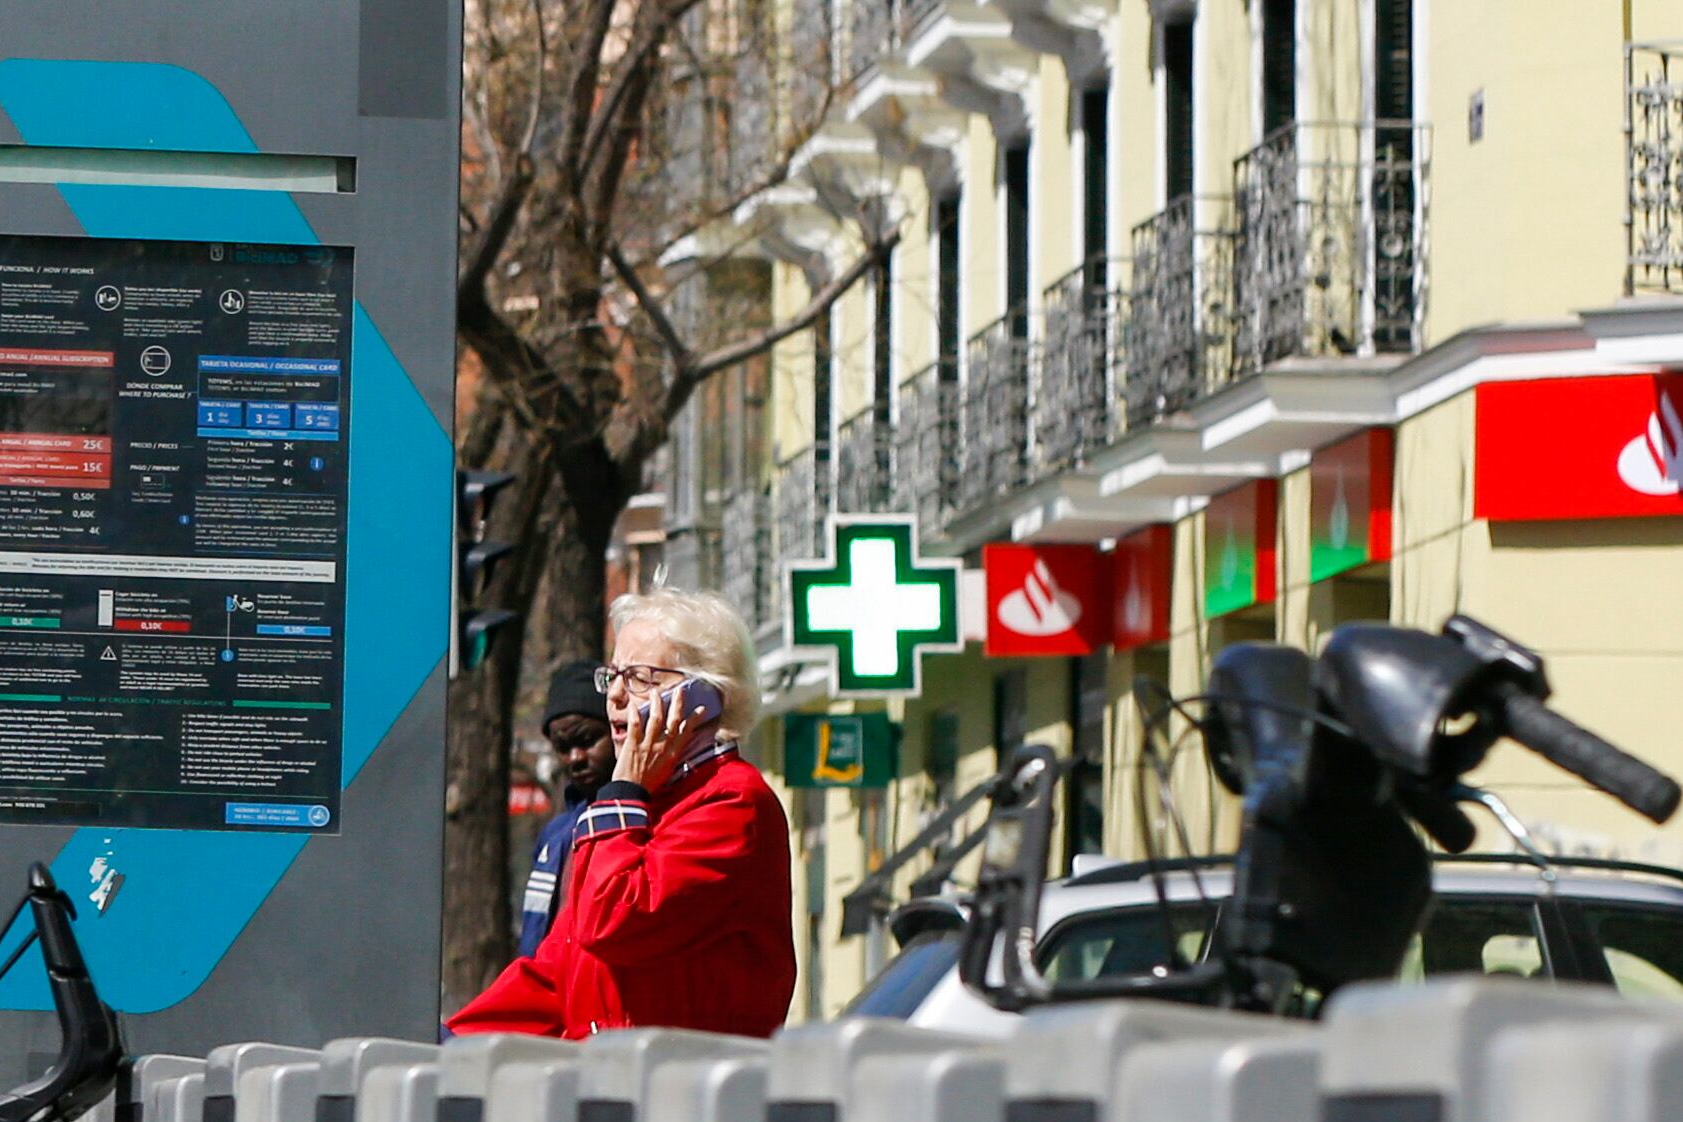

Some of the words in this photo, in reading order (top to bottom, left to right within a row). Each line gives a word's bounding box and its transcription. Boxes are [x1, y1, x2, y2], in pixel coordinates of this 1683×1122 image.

[207, 412, 213, 422] 1
[255, 413, 263, 424] 3
[305, 415, 313, 425] 5
[83, 439, 102, 450] 25€
[82, 462, 102, 473] 15€
